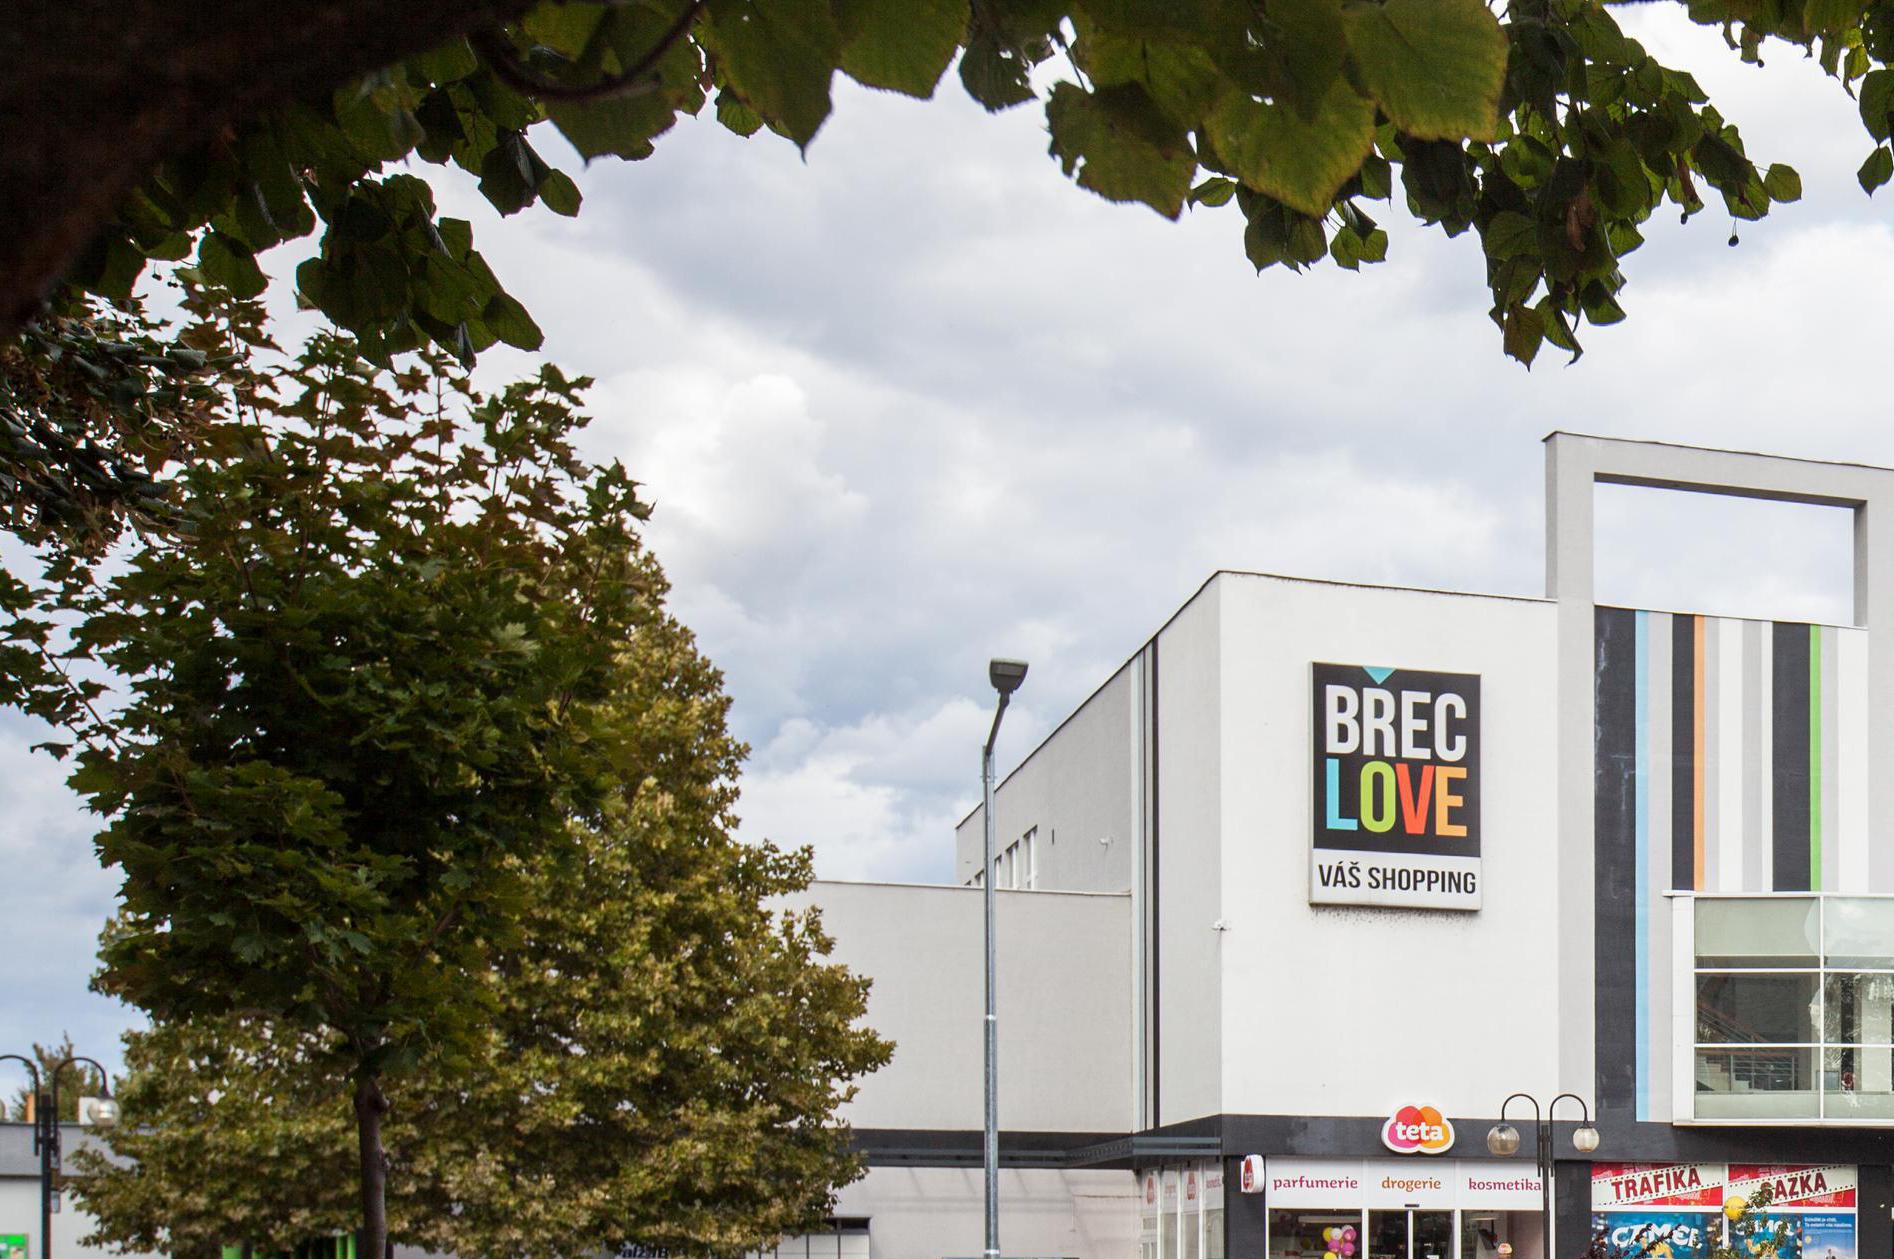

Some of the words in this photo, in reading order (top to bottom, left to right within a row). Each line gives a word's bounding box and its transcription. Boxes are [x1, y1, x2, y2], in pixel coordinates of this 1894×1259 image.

[1326, 758, 1467, 837] LOVE
[1318, 860, 1361, 888] VÁŠ
[1367, 865, 1477, 894] SHOPPING
[1396, 1121, 1443, 1141] teta
[1273, 1176, 1359, 1191] parfumerie
[1381, 1176, 1441, 1191] drogerie
[1468, 1177, 1542, 1191] kosmetika
[1611, 1167, 1701, 1200] TRAFIKA
[1611, 1223, 1703, 1249] CAMEL
